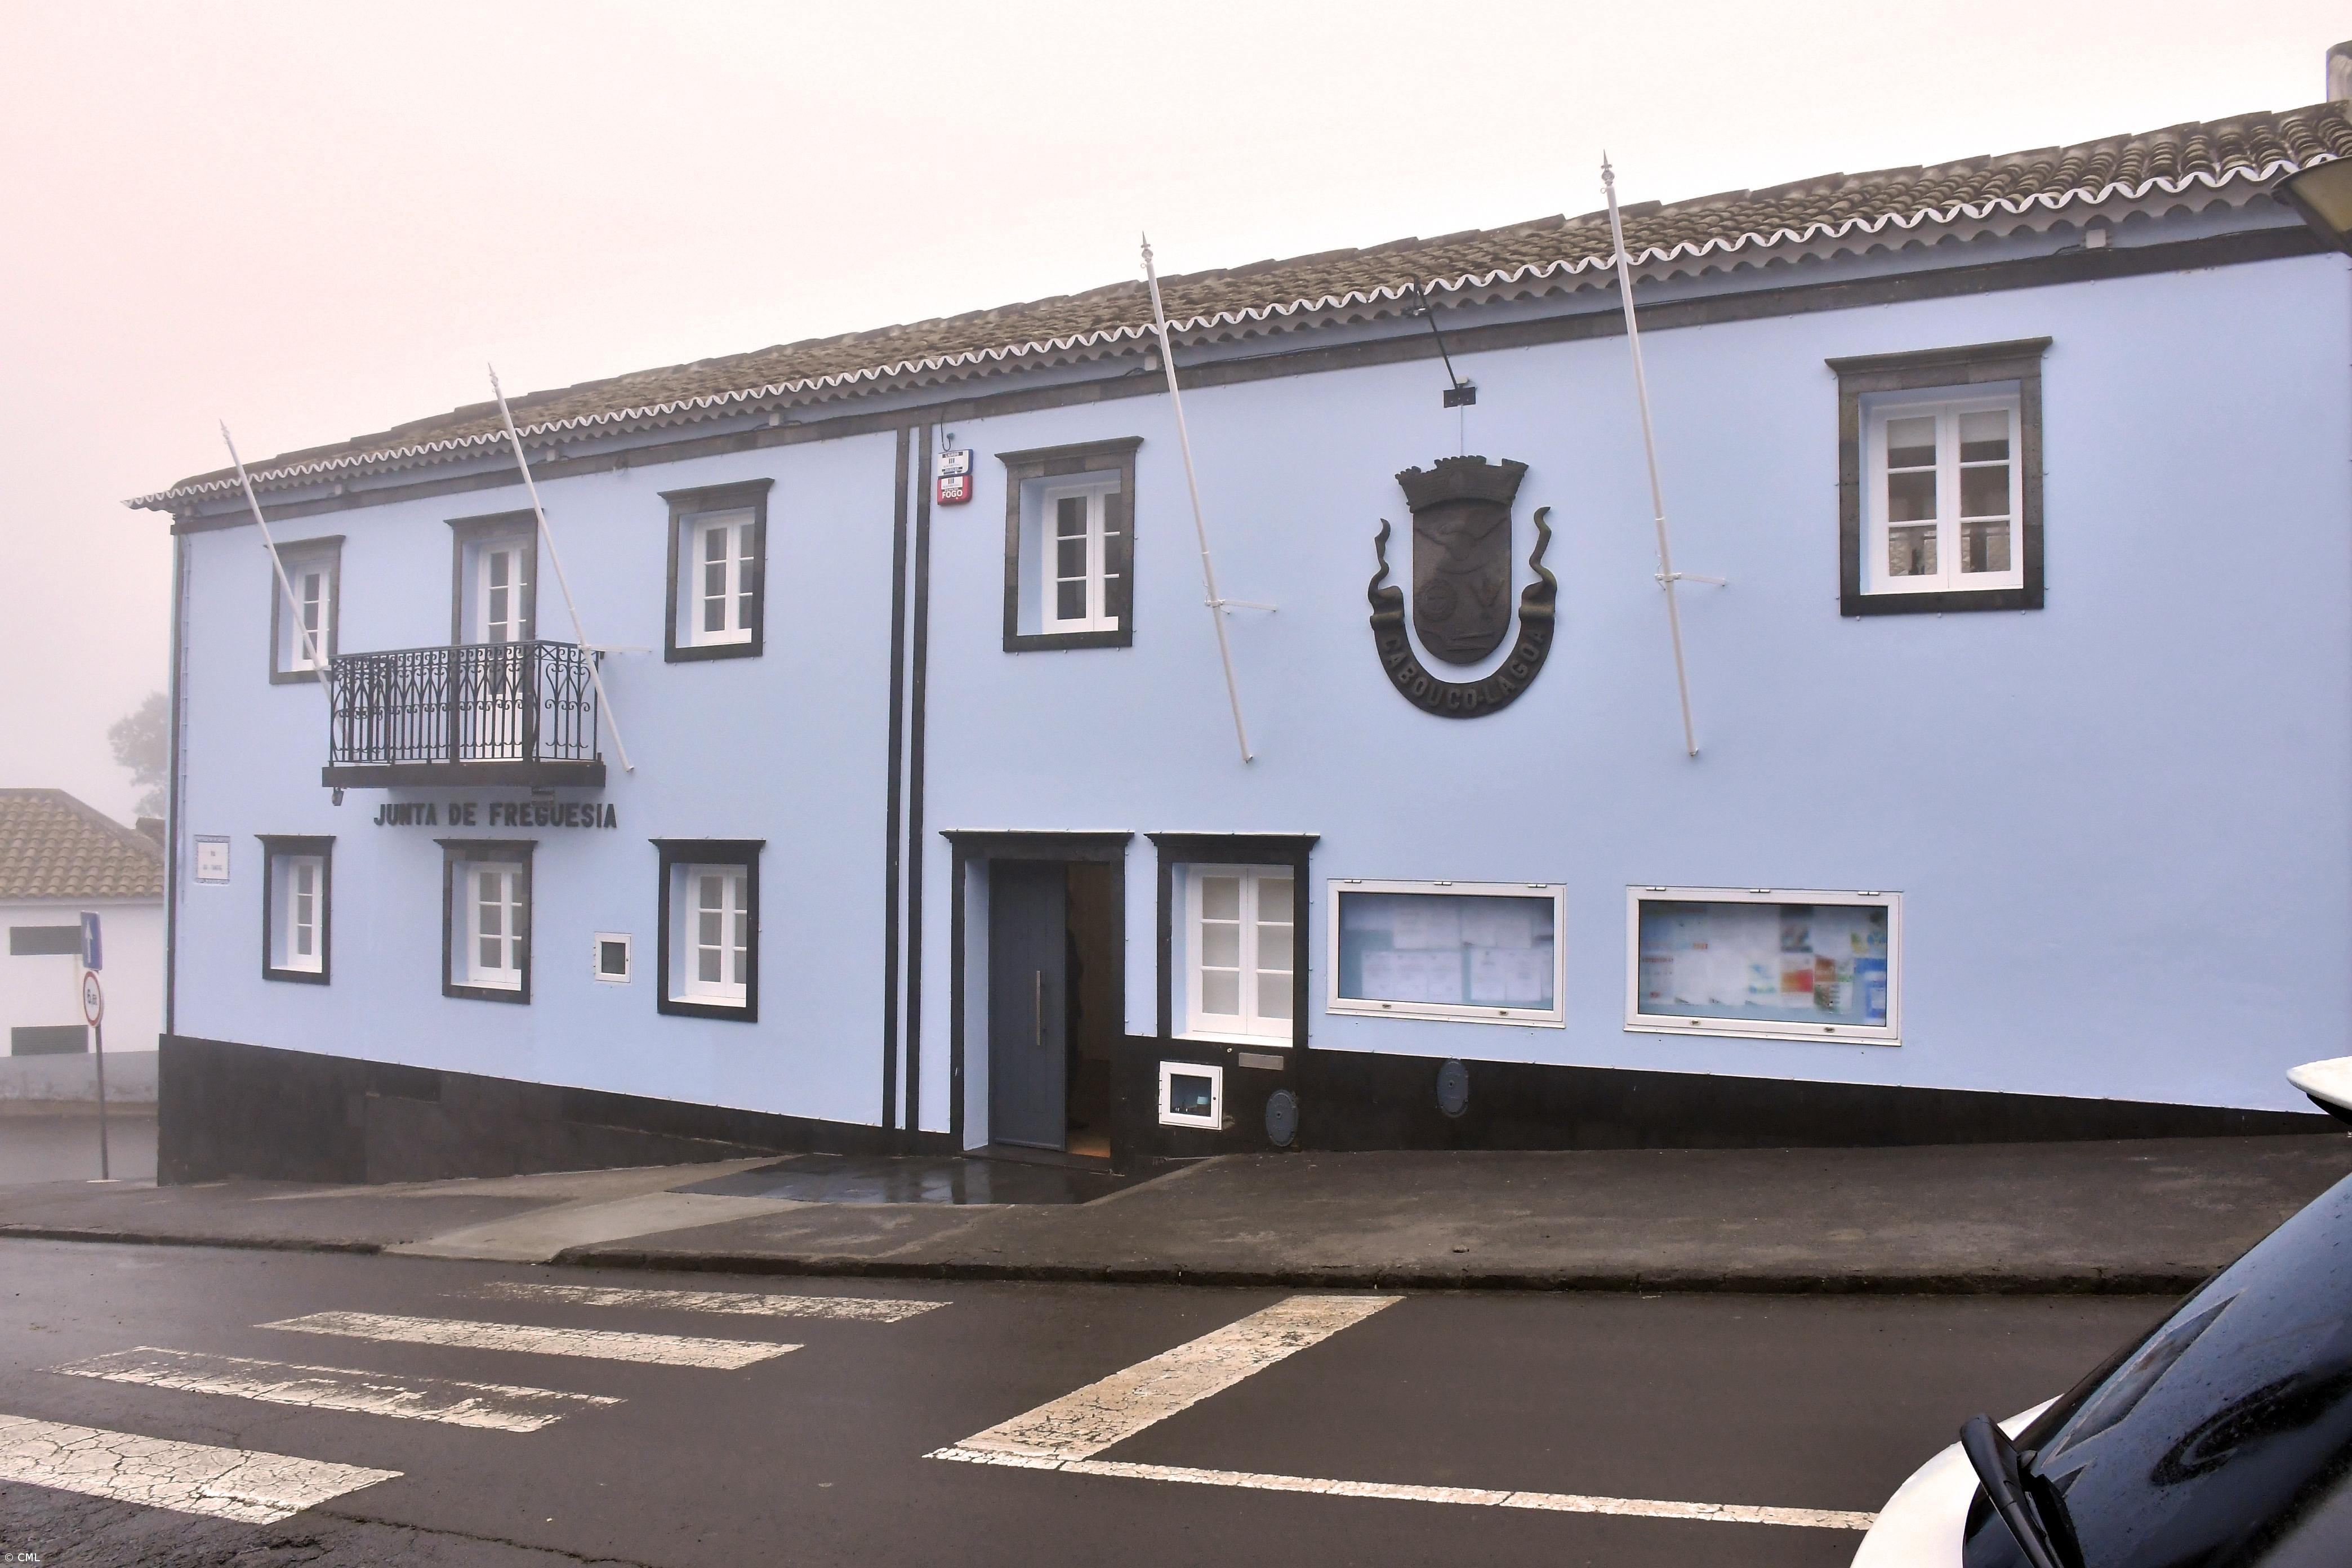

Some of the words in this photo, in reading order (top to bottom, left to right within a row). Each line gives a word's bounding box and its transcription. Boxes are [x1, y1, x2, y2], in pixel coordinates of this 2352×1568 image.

[942, 489, 963, 499] FOGO
[373, 803, 437, 826] JUNTA
[448, 803, 477, 826] DE
[489, 803, 617, 828] FREGUESIA
